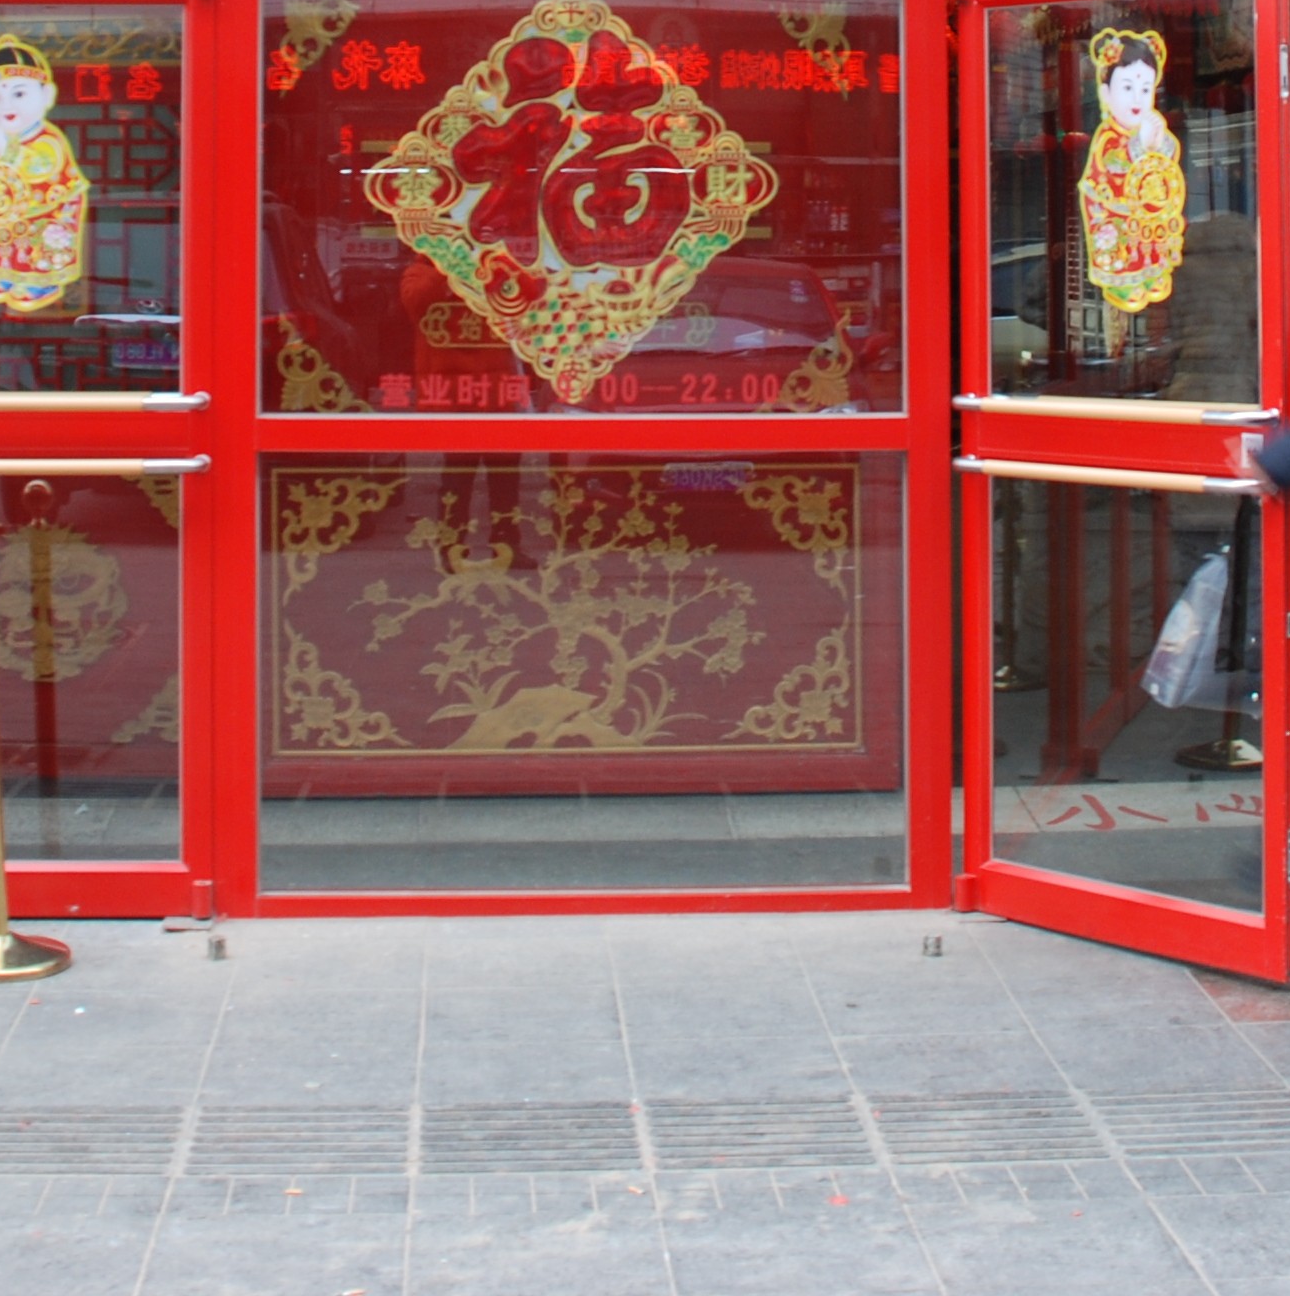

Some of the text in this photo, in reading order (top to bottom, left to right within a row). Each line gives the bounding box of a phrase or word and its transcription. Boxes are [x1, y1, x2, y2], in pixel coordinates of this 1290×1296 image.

[453, 30, 691, 268] 福
[379, 373, 531, 408] 营业时间
